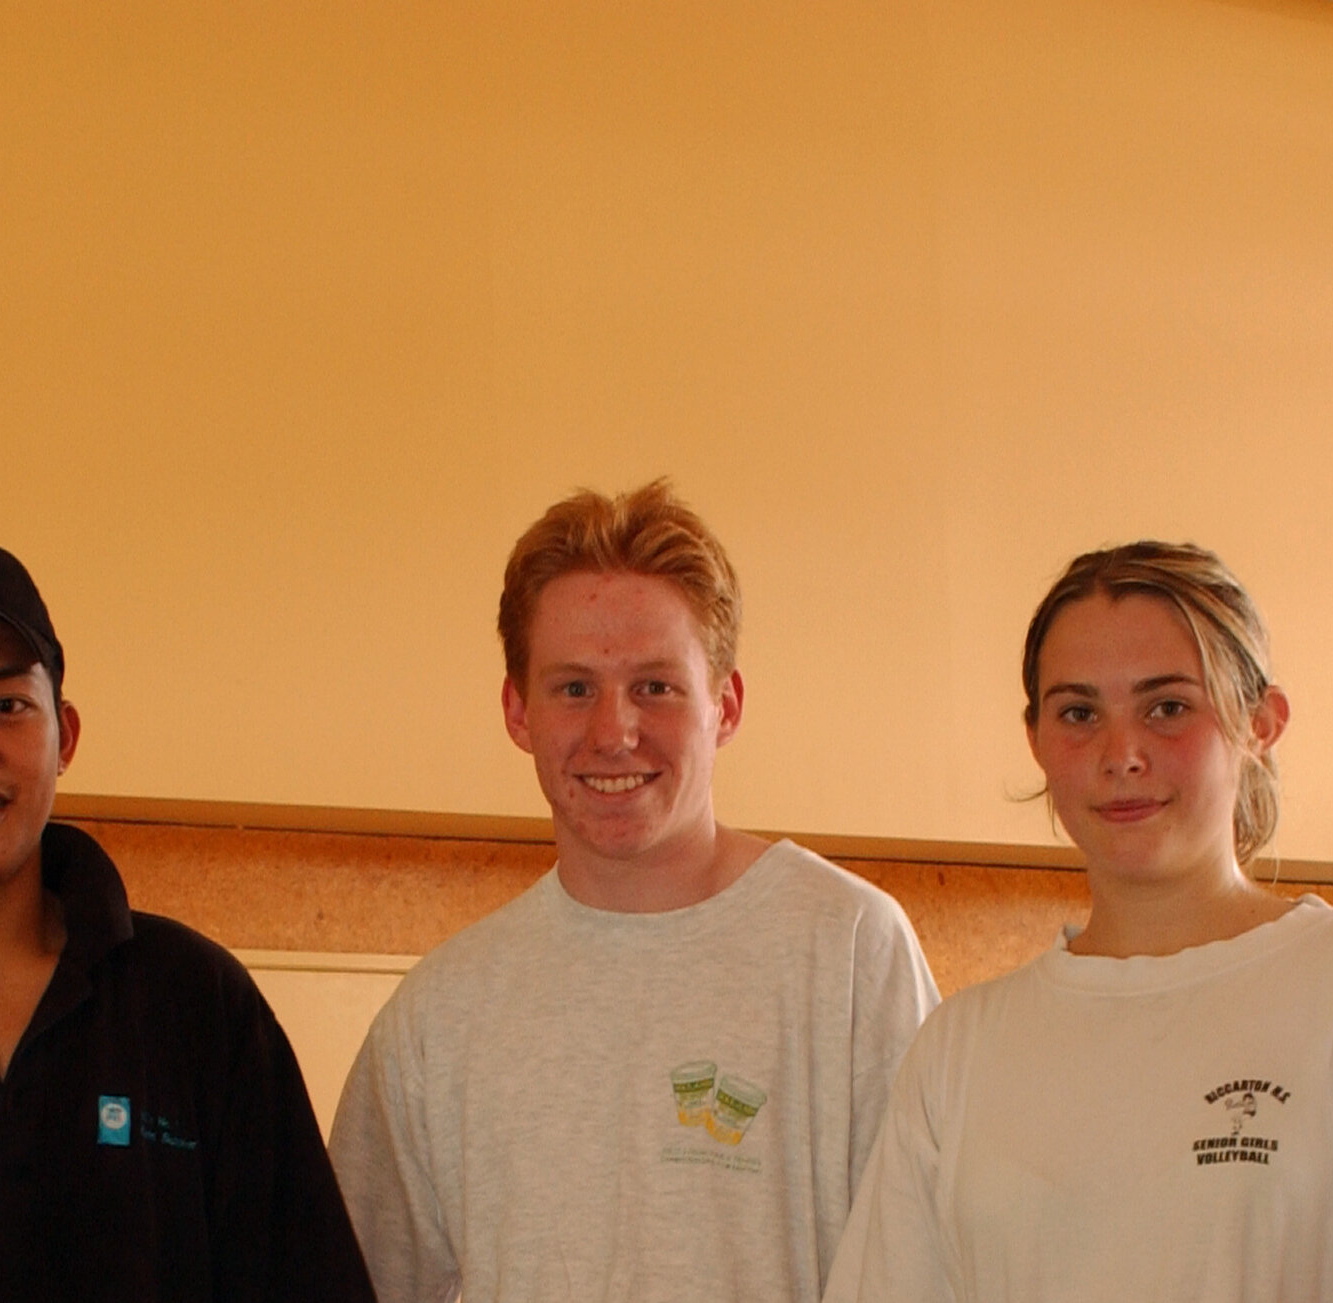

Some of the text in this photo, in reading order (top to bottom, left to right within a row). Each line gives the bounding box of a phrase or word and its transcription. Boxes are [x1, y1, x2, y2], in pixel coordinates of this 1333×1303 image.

[1204, 1079, 1271, 1104] RICCARTON
[1193, 1136, 1278, 1152] SENIOR GIRLS
[1196, 1150, 1269, 1166] VOLLEYBALL
